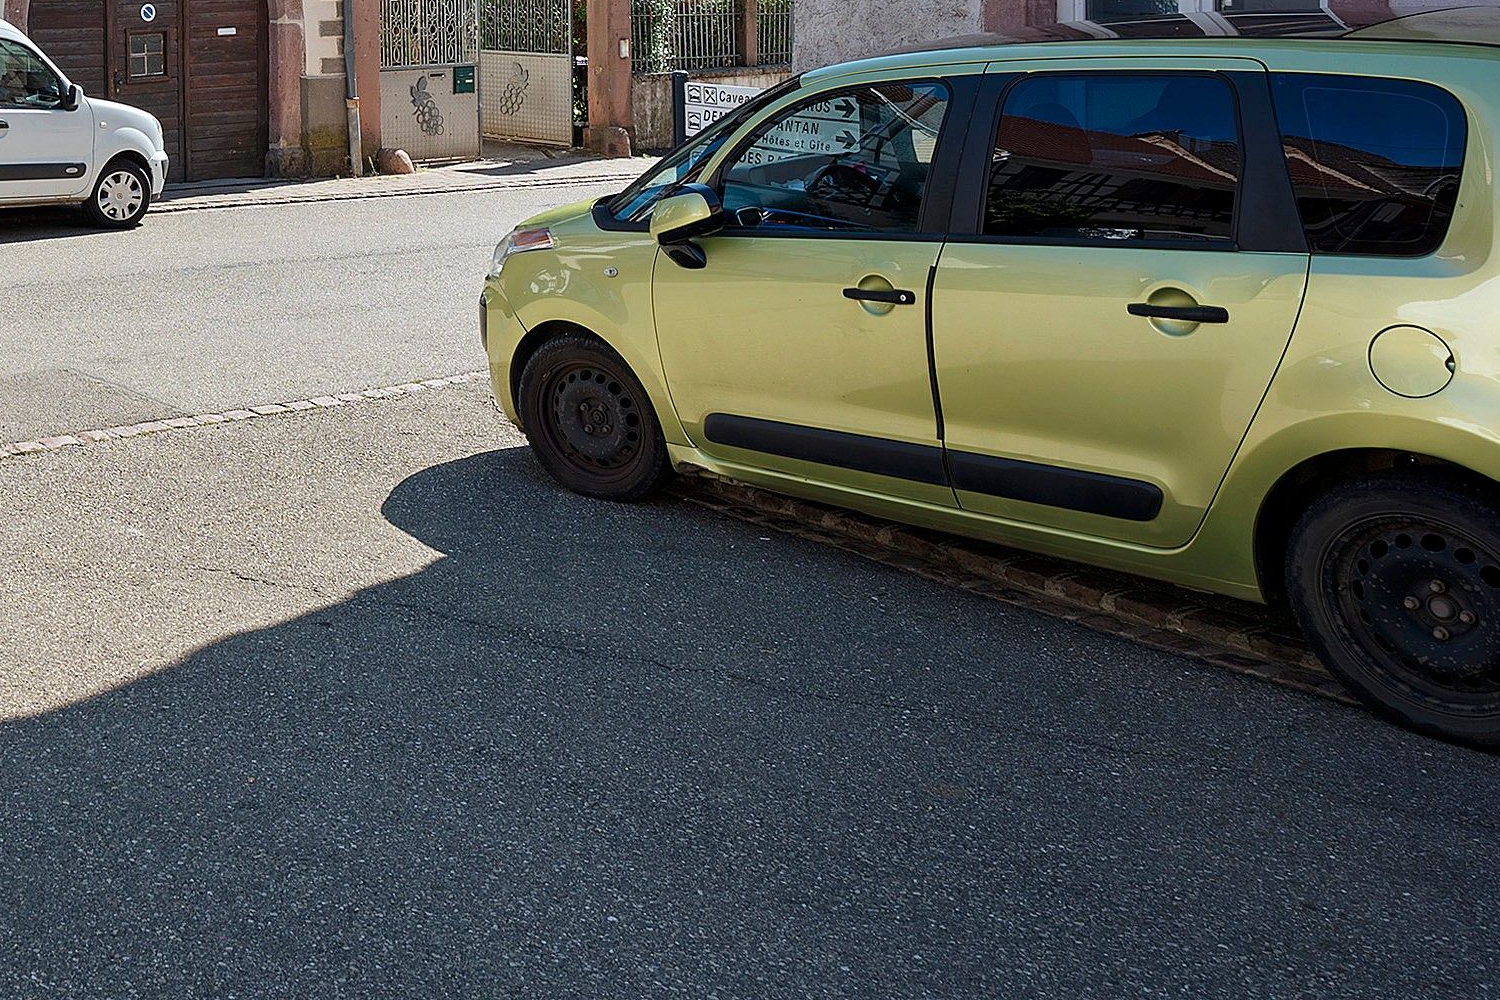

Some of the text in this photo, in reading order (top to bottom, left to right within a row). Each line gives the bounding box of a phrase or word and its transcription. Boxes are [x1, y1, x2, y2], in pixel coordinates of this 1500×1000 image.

[719, 90, 753, 103] Cavea
[794, 140, 805, 148] et
[809, 140, 831, 152] Gîte
